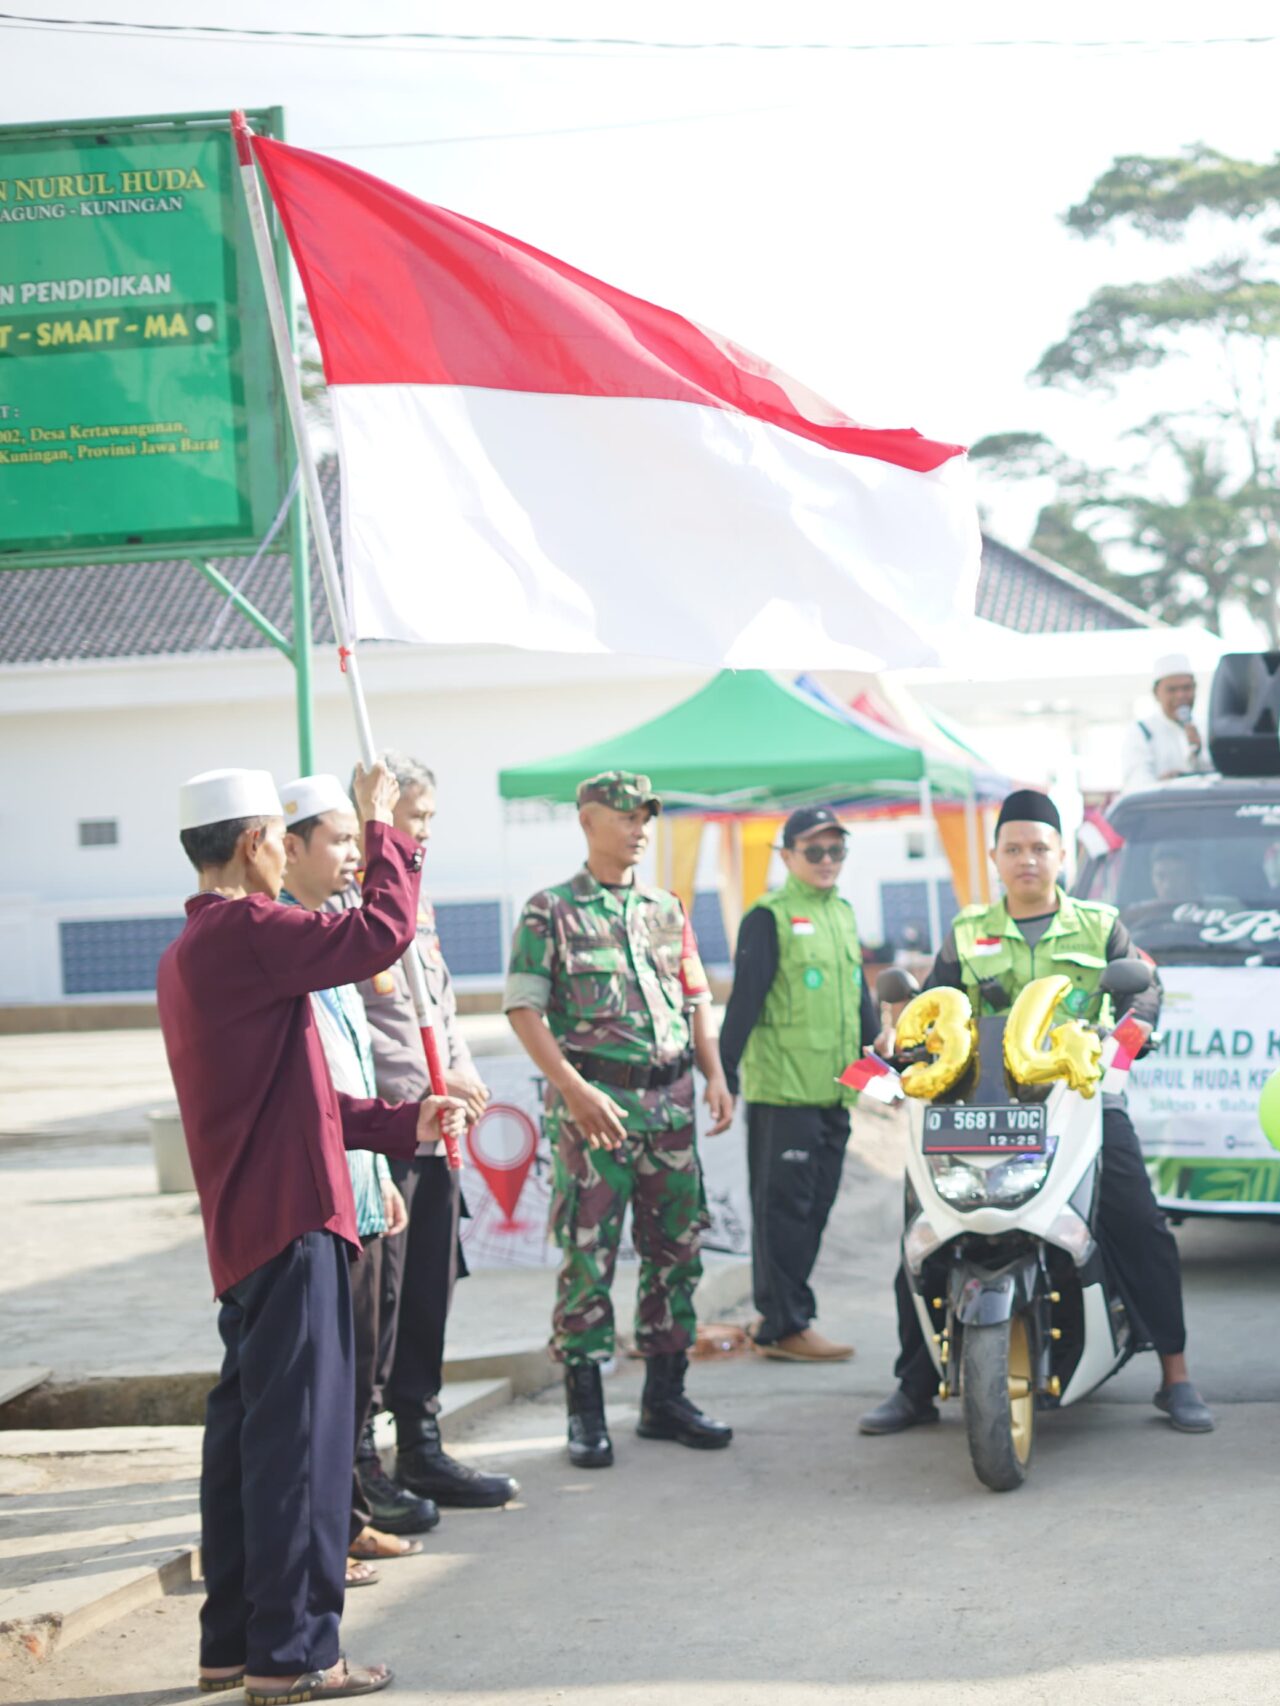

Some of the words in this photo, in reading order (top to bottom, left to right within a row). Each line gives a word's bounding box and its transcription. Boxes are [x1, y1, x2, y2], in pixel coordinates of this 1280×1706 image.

[15, 174, 115, 201] NURUL
[121, 168, 206, 194] HUDA
[80, 197, 183, 217] KUNINGAN
[20, 273, 172, 304] PENDIDIKAN
[37, 317, 121, 347] SMAIT
[144, 313, 189, 339] MA
[31, 427, 66, 442] Desa
[70, 420, 189, 440] Kertawangunan,
[78, 442, 136, 460] Provinsi
[141, 440, 177, 456] Jawa
[181, 437, 221, 452] Barat
[1193, 1068, 1241, 1090] HUDA
[953, 1111, 997, 1130] 5681
[1006, 1110, 1041, 1129] VDC
